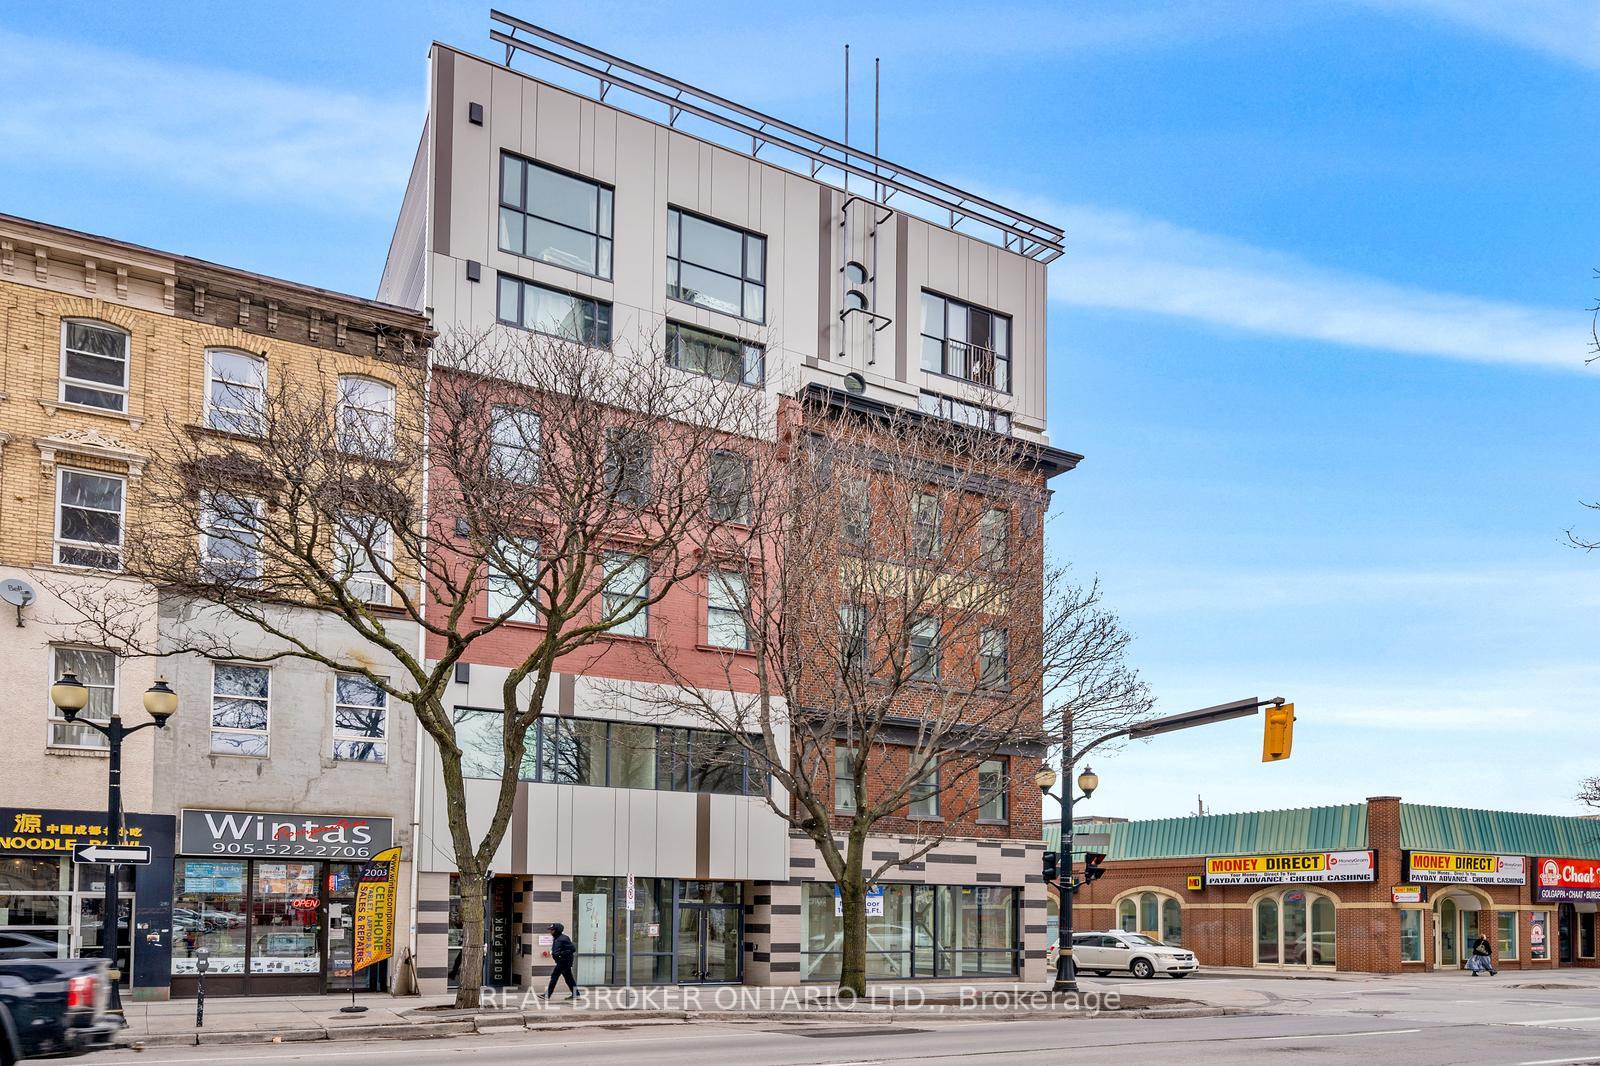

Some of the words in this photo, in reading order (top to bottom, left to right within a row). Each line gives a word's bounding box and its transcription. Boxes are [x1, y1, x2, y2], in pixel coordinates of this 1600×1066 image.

[205, 813, 372, 844] Wintas
[0, 837, 76, 851] NOODLE
[212, 842, 370, 858] 905-522-2706
[1212, 859, 1257, 871] MONEY
[1266, 856, 1320, 870] DIRECT
[1413, 855, 1450, 869] MONEY
[1455, 857, 1492, 871] DIRECT
[364, 868, 388, 877] 2003
[1562, 865, 1595, 883] Chaat
[358, 886, 368, 913] SALES
[1542, 889, 1566, 898] GOLGAPPA
[1569, 890, 1584, 899] CHAAT
[293, 899, 318, 908] OPEN
[374, 886, 386, 951] CELLPHONE
[495, 918, 504, 947] PARK
[356, 925, 365, 963] REPAIRS
[494, 952, 503, 980] GORE
